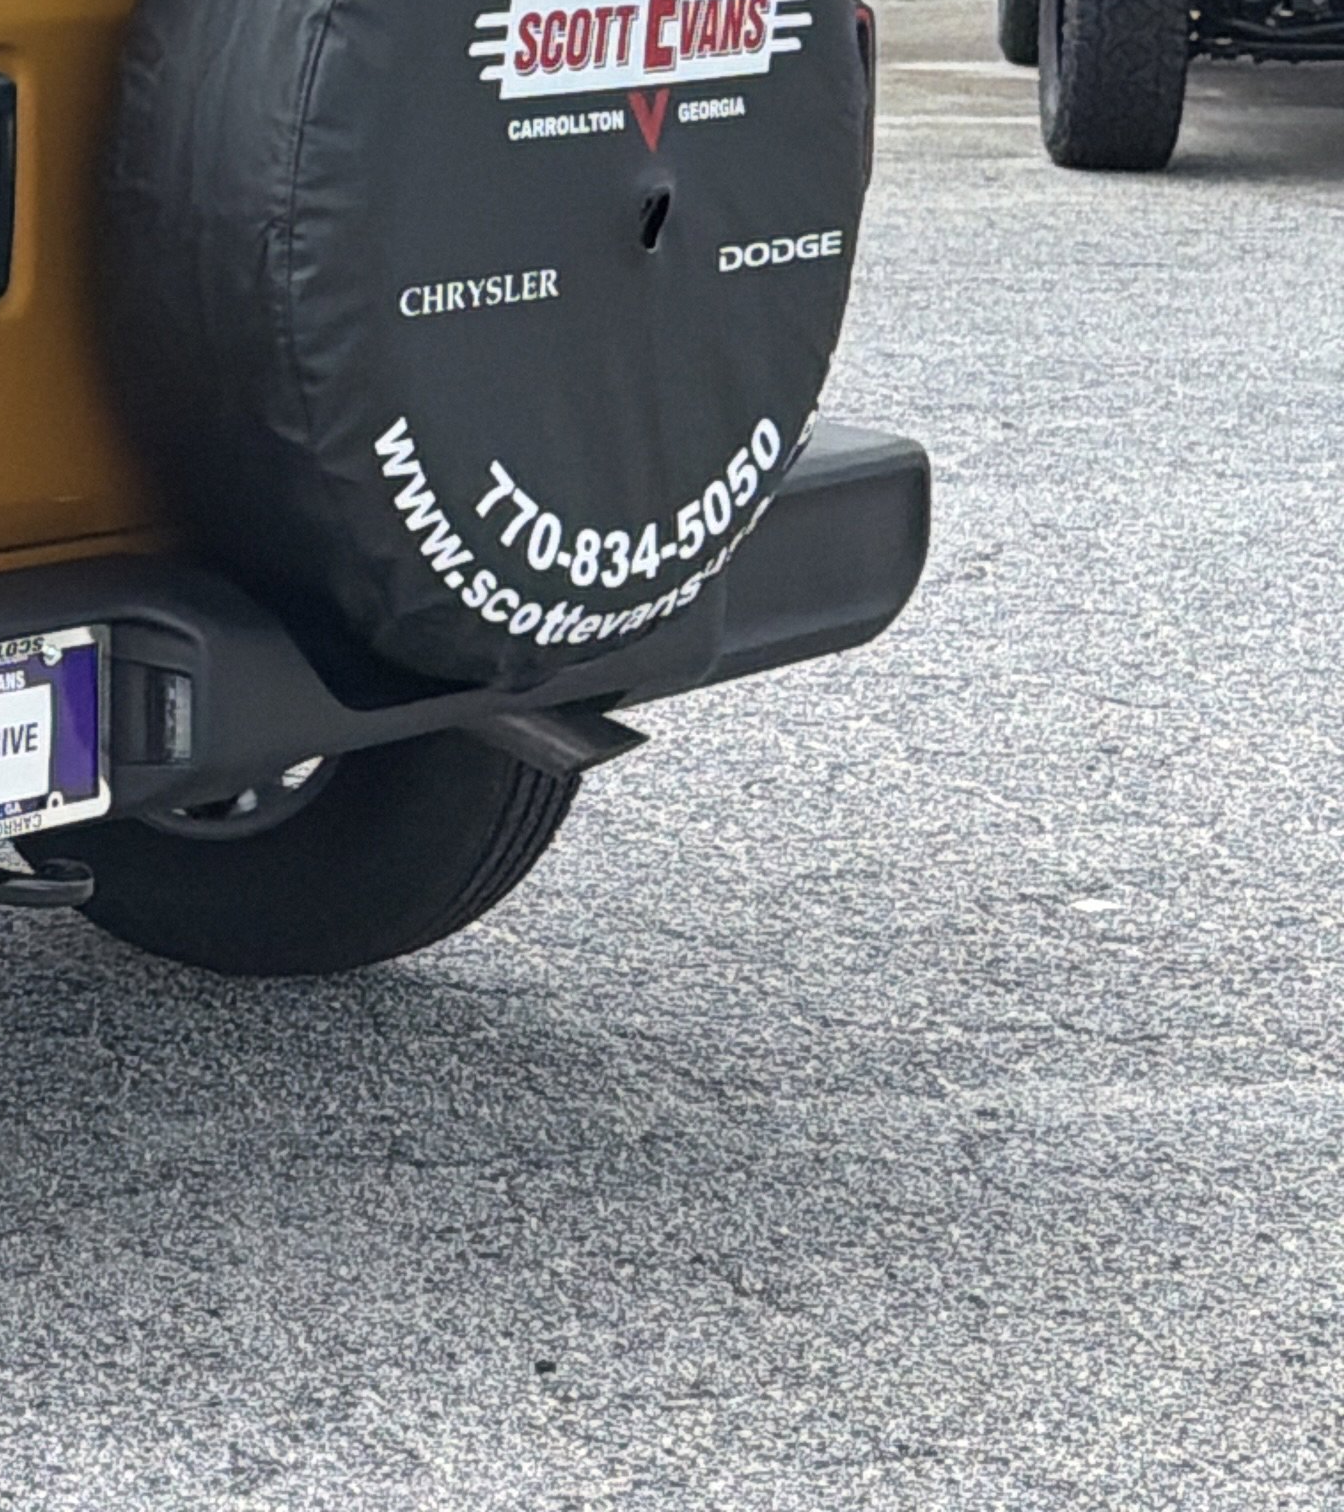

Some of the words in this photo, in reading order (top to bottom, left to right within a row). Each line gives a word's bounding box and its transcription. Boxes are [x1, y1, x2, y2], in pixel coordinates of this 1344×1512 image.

[514, 5, 640, 76] SCOTT
[508, 108, 625, 141] CARROLLTON
[677, 95, 745, 124] GEORGIA
[718, 229, 843, 273] DODGE
[399, 268, 560, 317] CHRYSLER
[474, 416, 781, 590] 770-834-5050
[4, 801, 23, 816] GA
